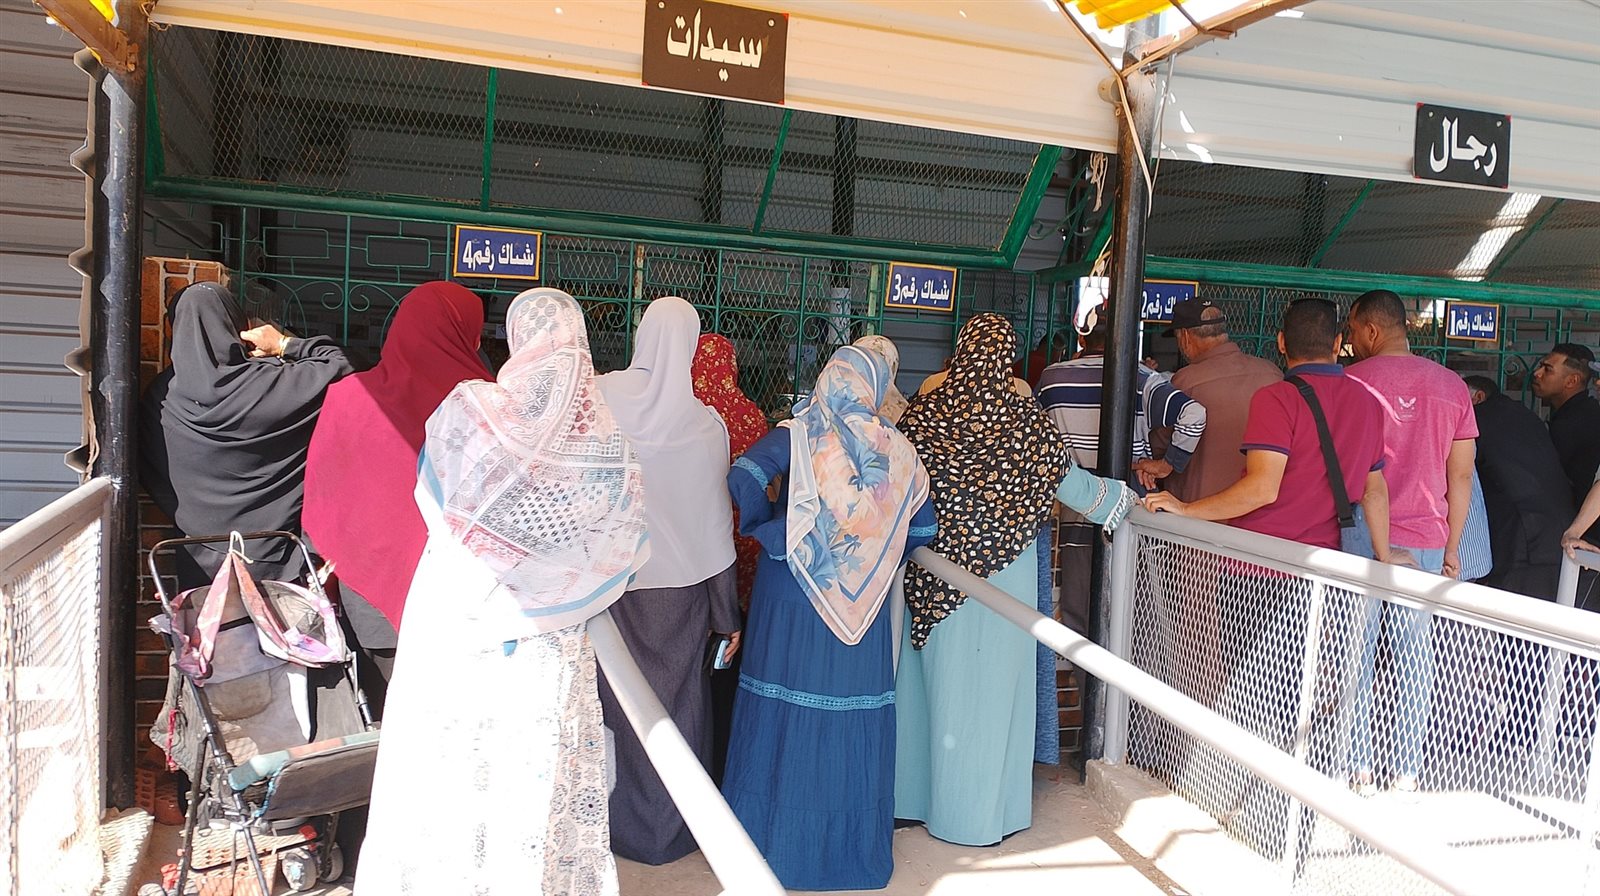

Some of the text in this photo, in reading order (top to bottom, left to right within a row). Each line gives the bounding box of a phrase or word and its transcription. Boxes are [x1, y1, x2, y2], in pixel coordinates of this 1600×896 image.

[666, 8, 762, 82] سيدات
[1430, 116, 1497, 177] رجال
[921, 280, 950, 304] شباك
[1472, 311, 1494, 337] شباك
